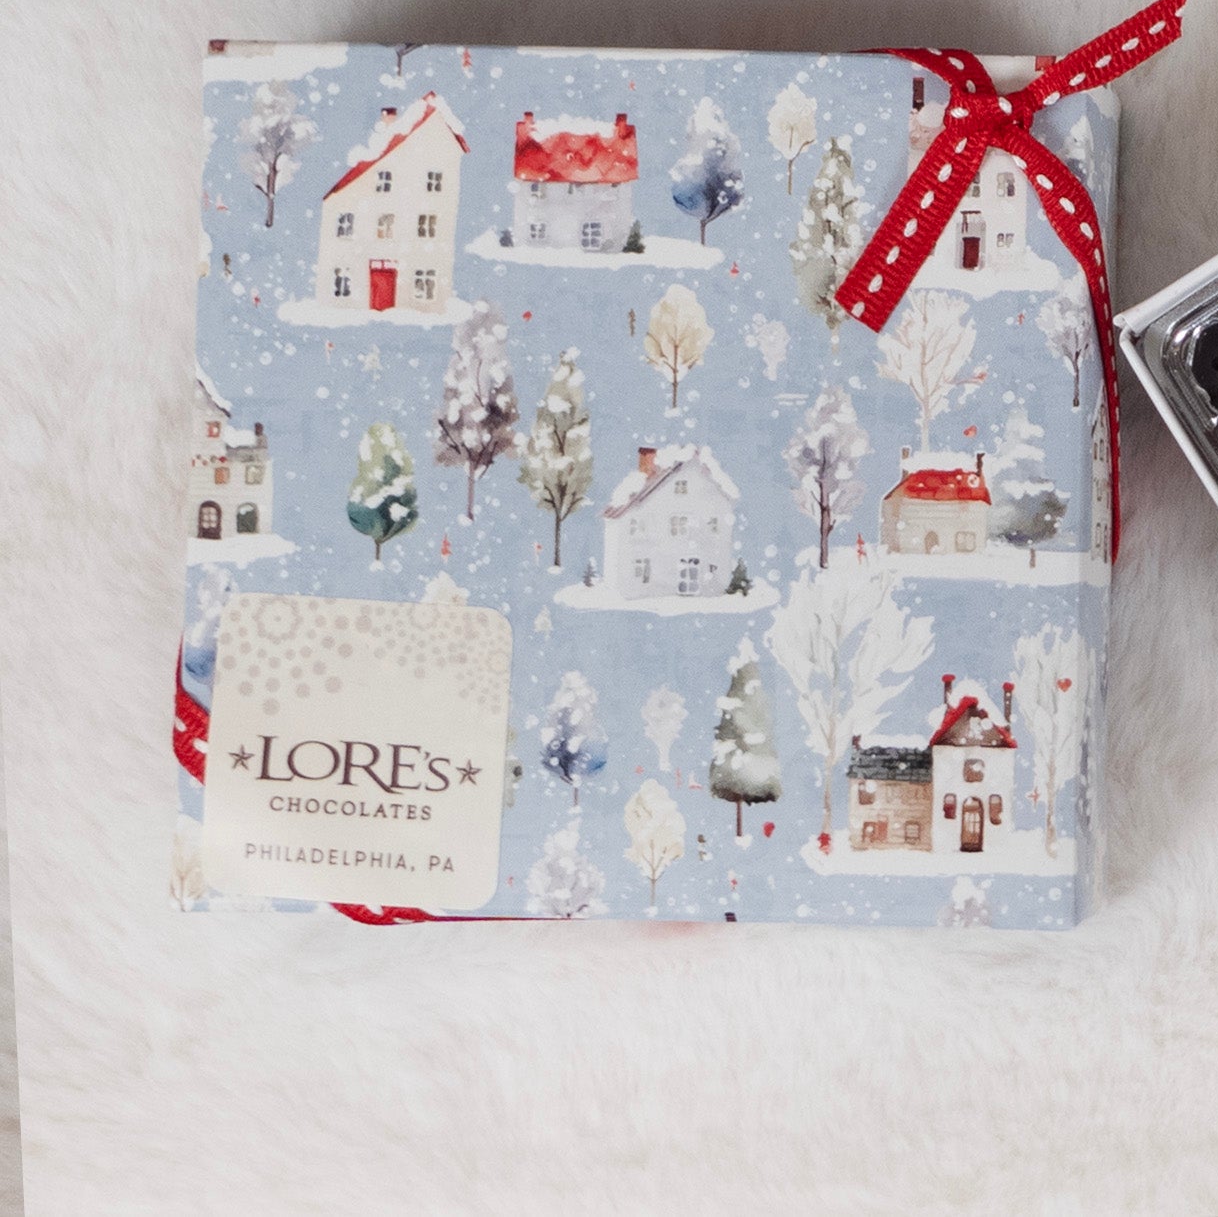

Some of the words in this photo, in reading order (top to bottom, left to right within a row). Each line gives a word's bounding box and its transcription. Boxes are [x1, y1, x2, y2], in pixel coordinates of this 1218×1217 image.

[269, 796, 433, 821] CHOCOLATES
[245, 842, 416, 872] PHILADELPHIA,
[428, 855, 455, 873] PA
